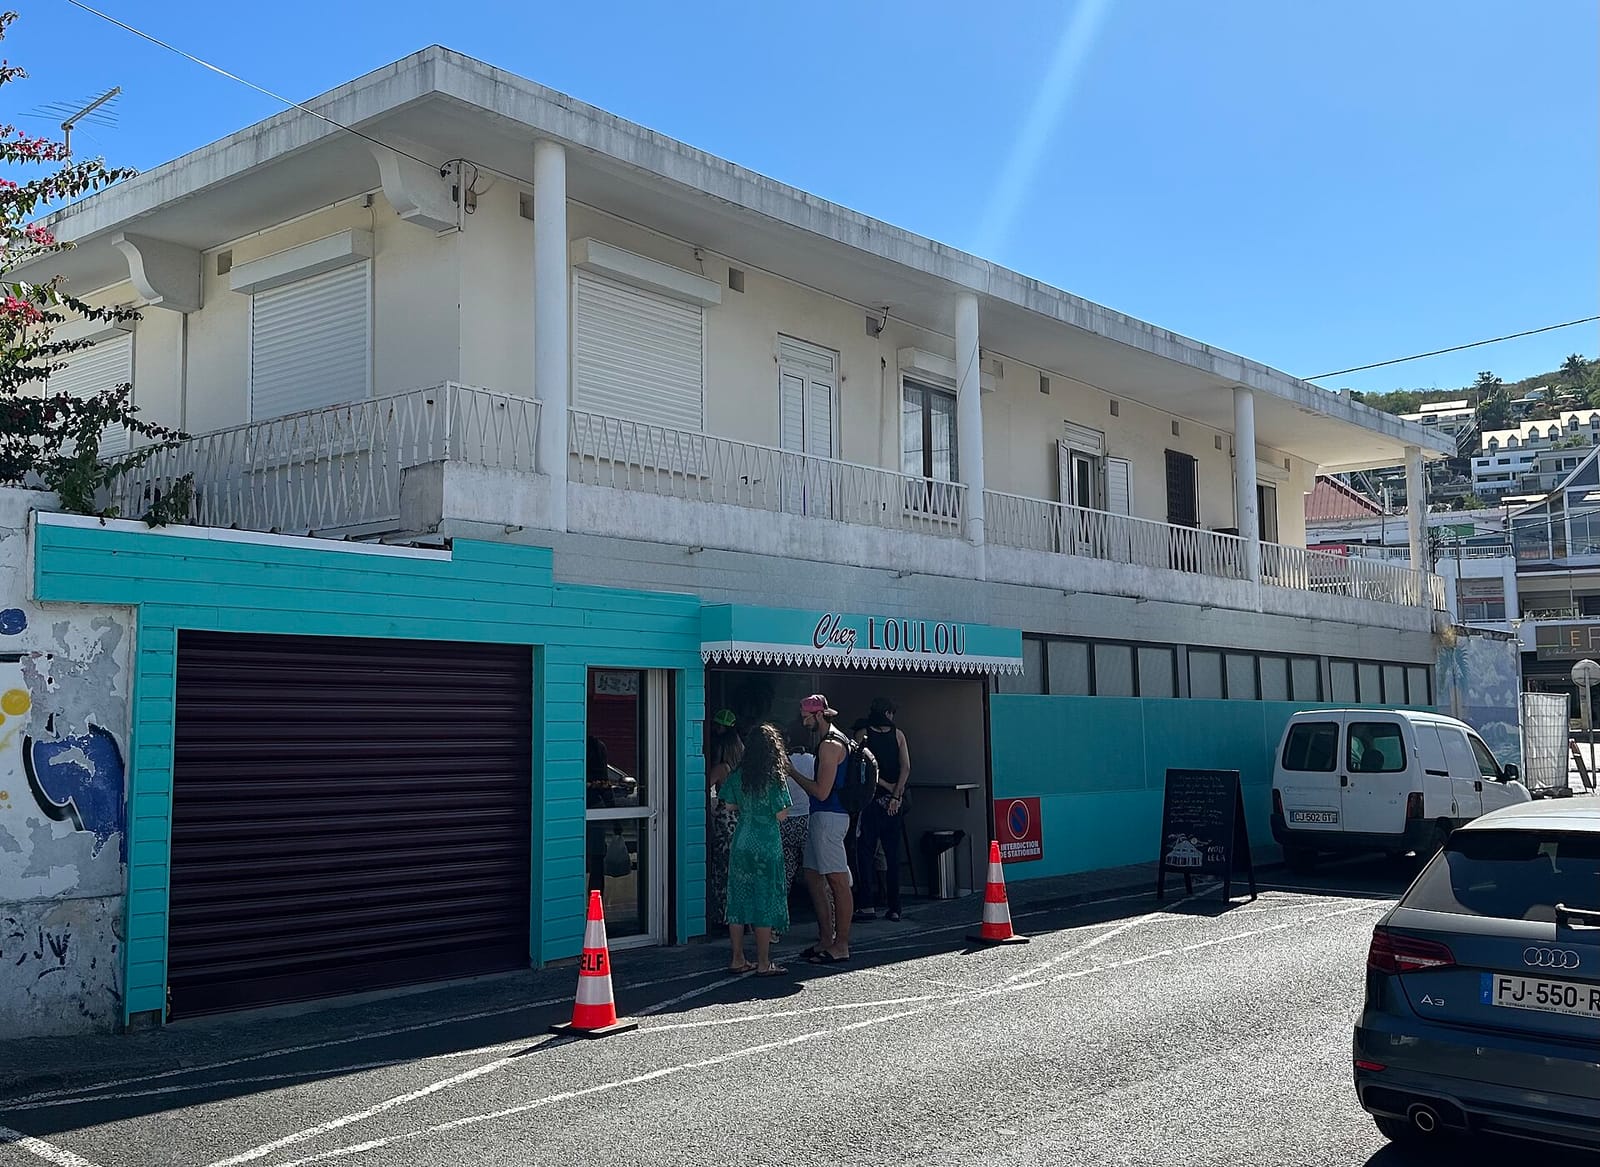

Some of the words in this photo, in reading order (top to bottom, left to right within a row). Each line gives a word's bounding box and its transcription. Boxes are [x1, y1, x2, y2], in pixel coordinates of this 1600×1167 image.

[812, 612, 857, 655] Chez
[868, 616, 965, 656] LOULOU
[1000, 840, 1039, 851] INTERDICTION
[1008, 847, 1041, 858] STATIONNER
[1421, 994, 1445, 1007] A3
